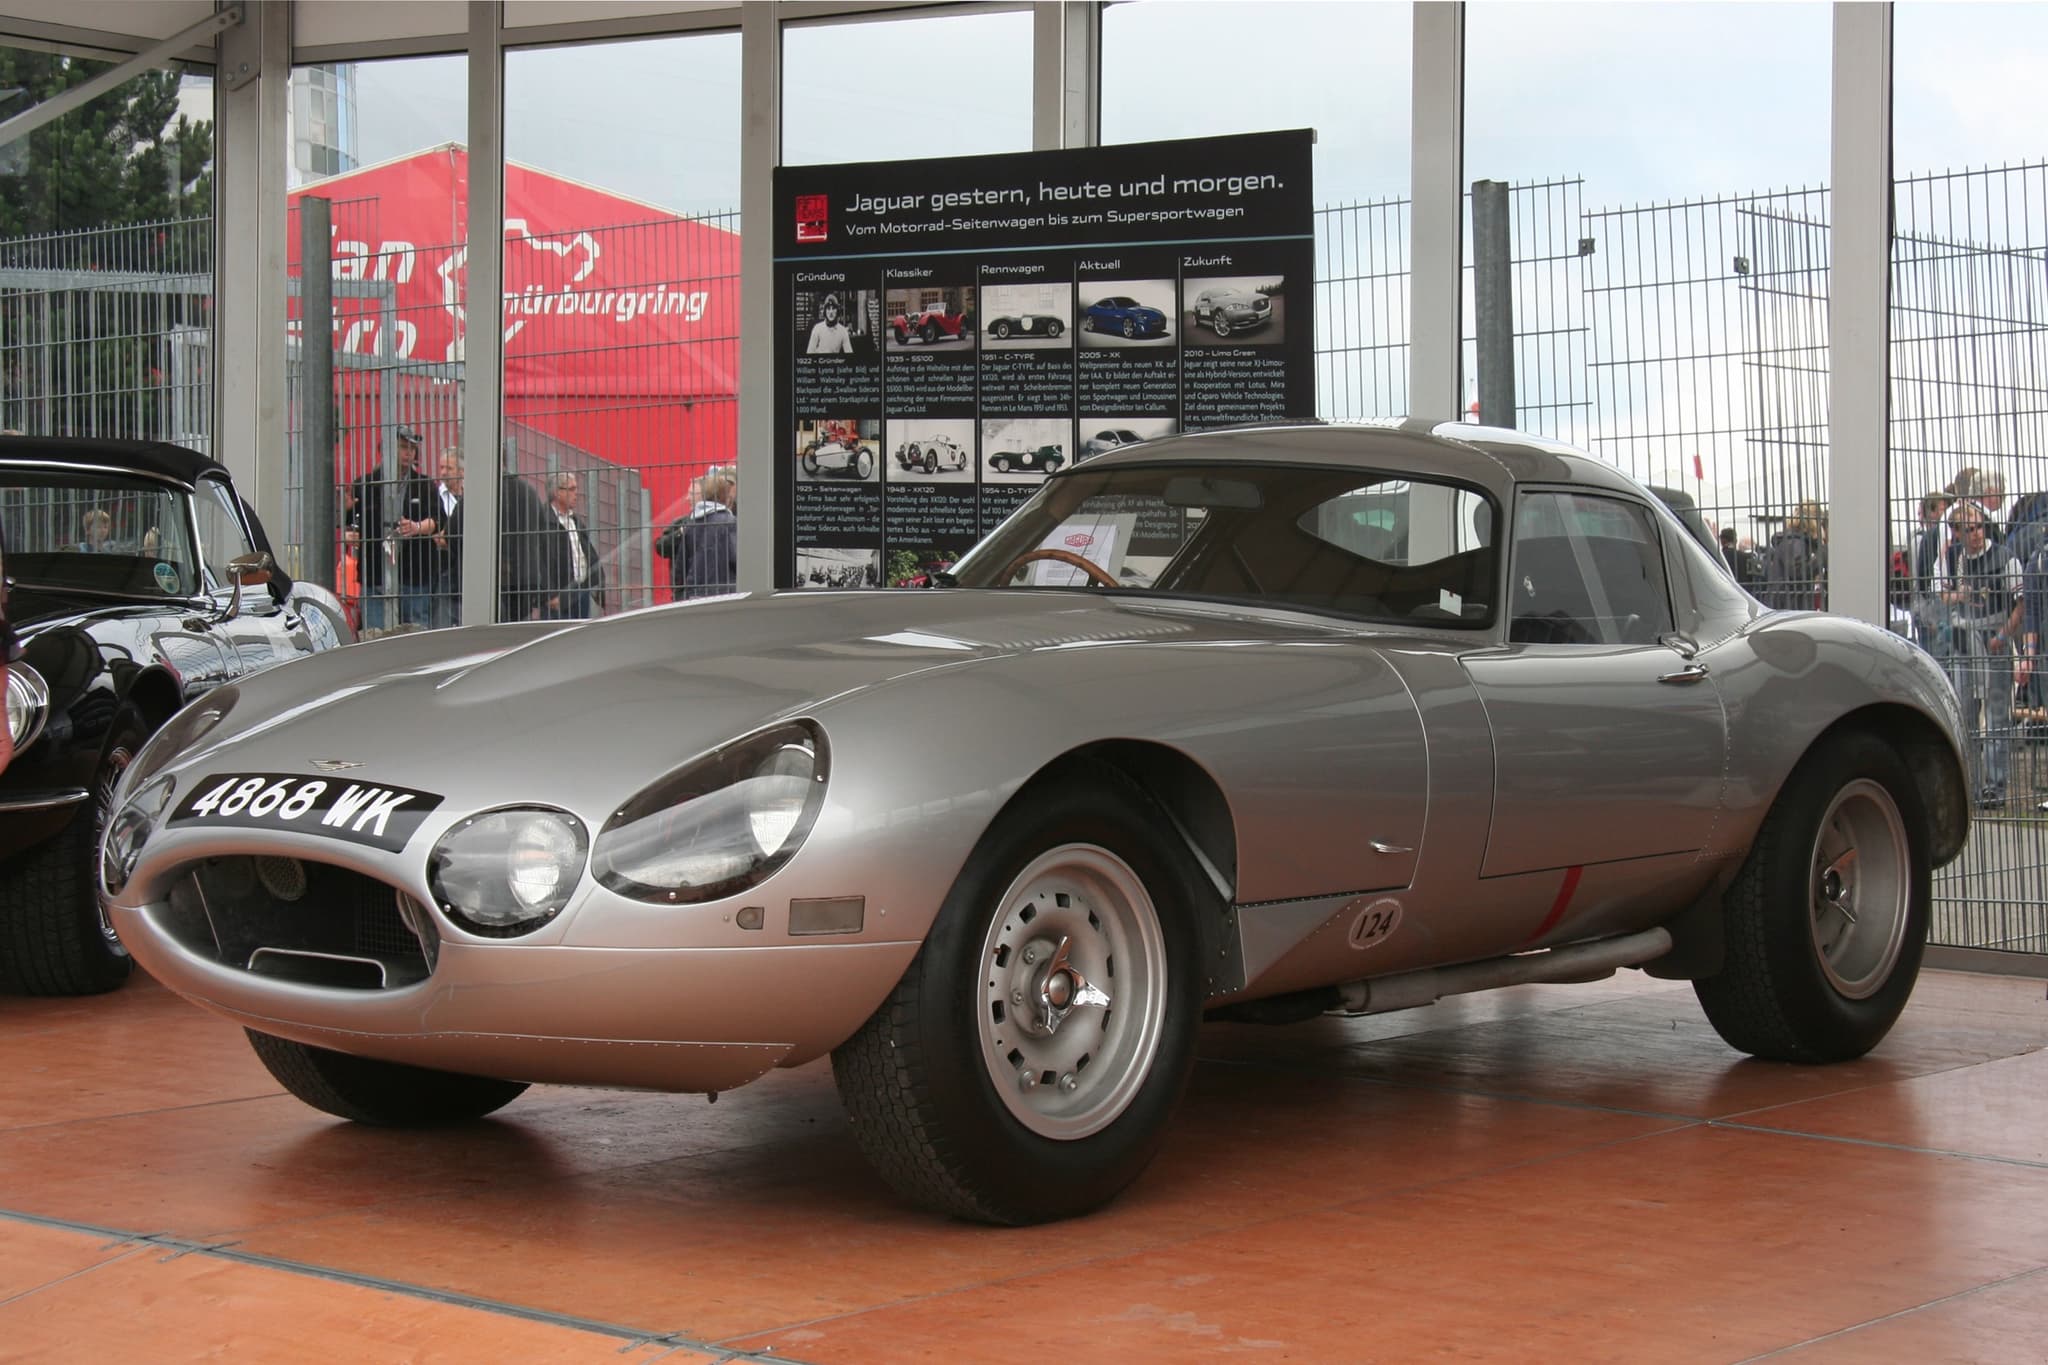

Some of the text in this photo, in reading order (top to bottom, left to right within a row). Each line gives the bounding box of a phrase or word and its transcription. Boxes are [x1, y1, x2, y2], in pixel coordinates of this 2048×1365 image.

[845, 193, 925, 215] Jaguar
[930, 188, 1031, 212] gestern,
[1039, 180, 1112, 201] heute
[1119, 173, 1165, 197] und
[1173, 174, 1284, 197] morgen.
[846, 207, 1244, 236] Vom Motorrad-Seitenwagen bis zum Supersportwagen
[332, 229, 415, 284] an
[1079, 258, 1121, 271] Aktuell
[1184, 254, 1232, 268] Zukunft
[796, 271, 846, 283] Gründung
[887, 267, 933, 279] Klassiker
[981, 262, 1046, 275] Rennwagen
[503, 284, 709, 322] nürburgring
[1079, 351, 1120, 359] 2005 XK
[190, 777, 416, 838] 4868 WK
[1355, 909, 1395, 941] 124
